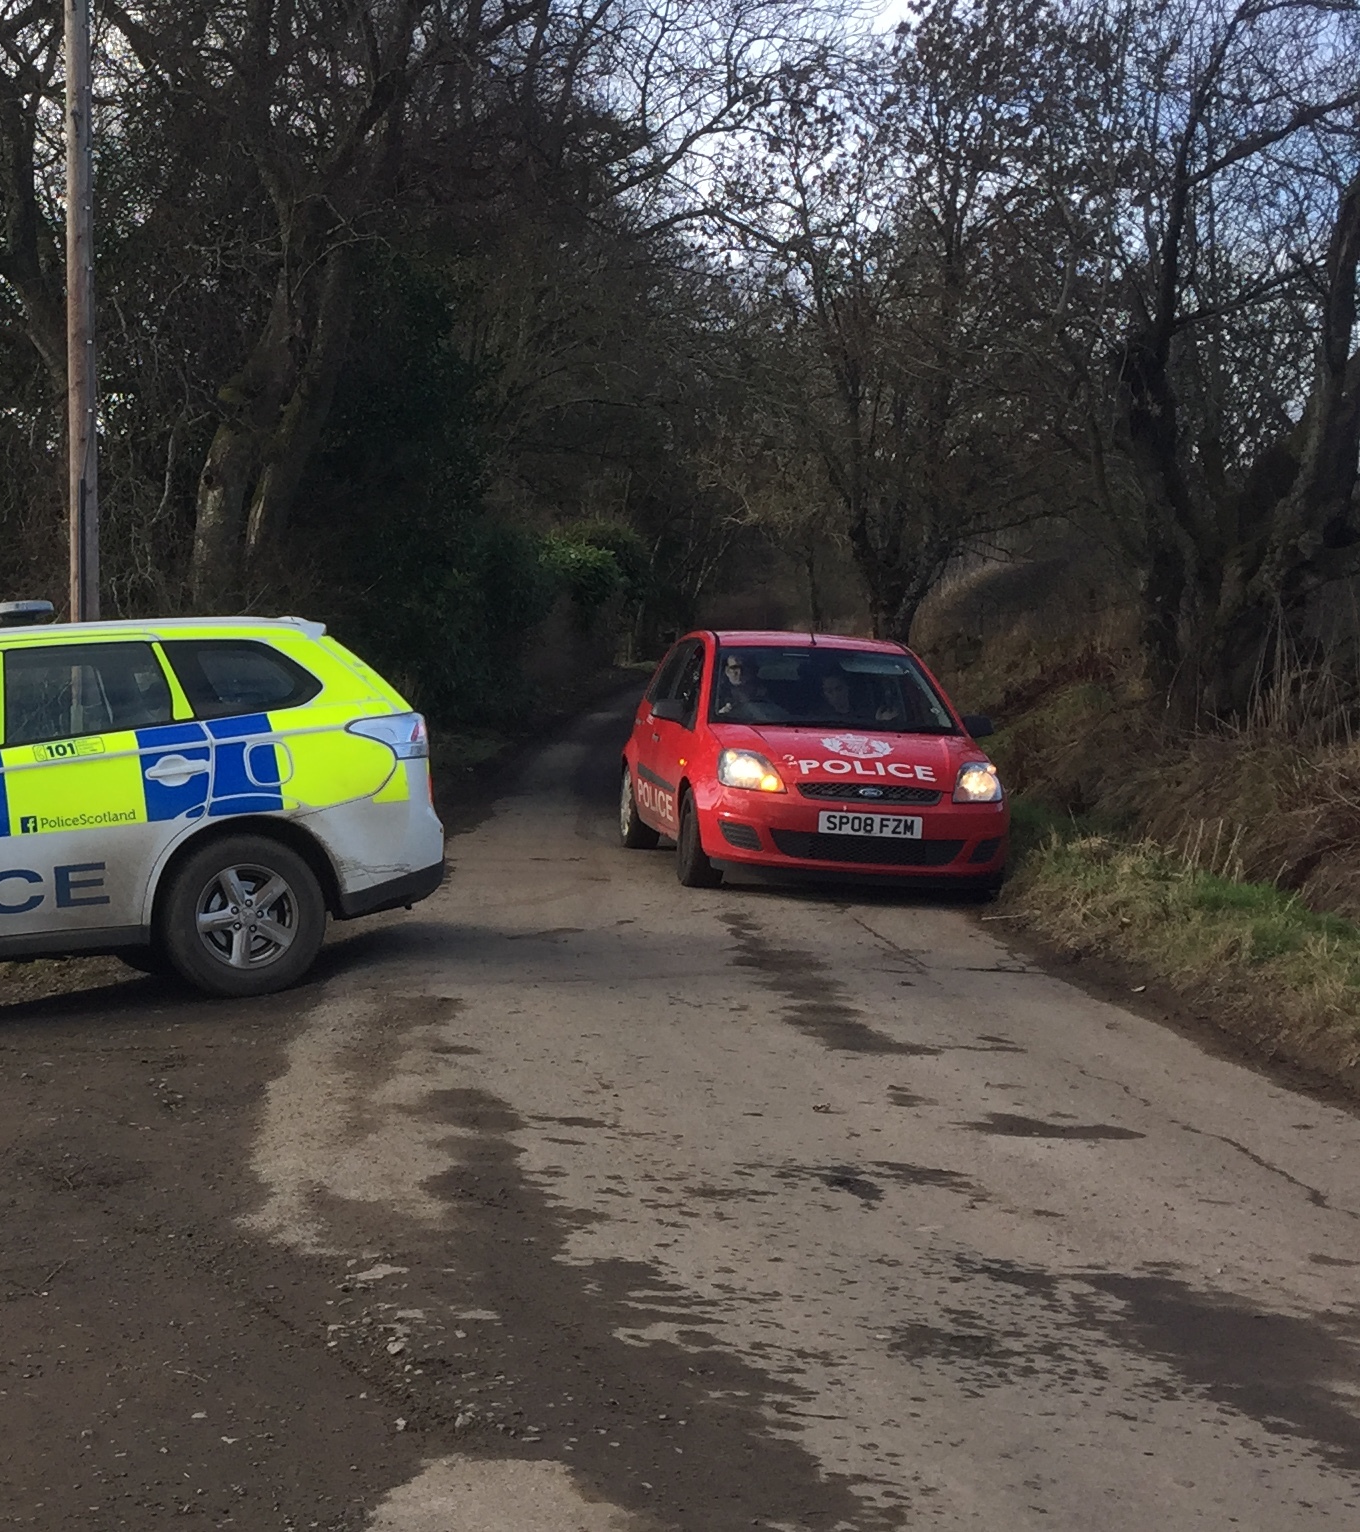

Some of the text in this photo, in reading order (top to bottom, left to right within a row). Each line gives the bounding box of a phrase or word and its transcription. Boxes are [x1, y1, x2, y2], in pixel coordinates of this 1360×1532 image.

[46, 742, 76, 758] 101
[798, 759, 938, 783] POLICE
[637, 778, 674, 822] POLICE
[40, 808, 137, 829] PoliceScotland
[826, 814, 915, 836] SP08 FZM
